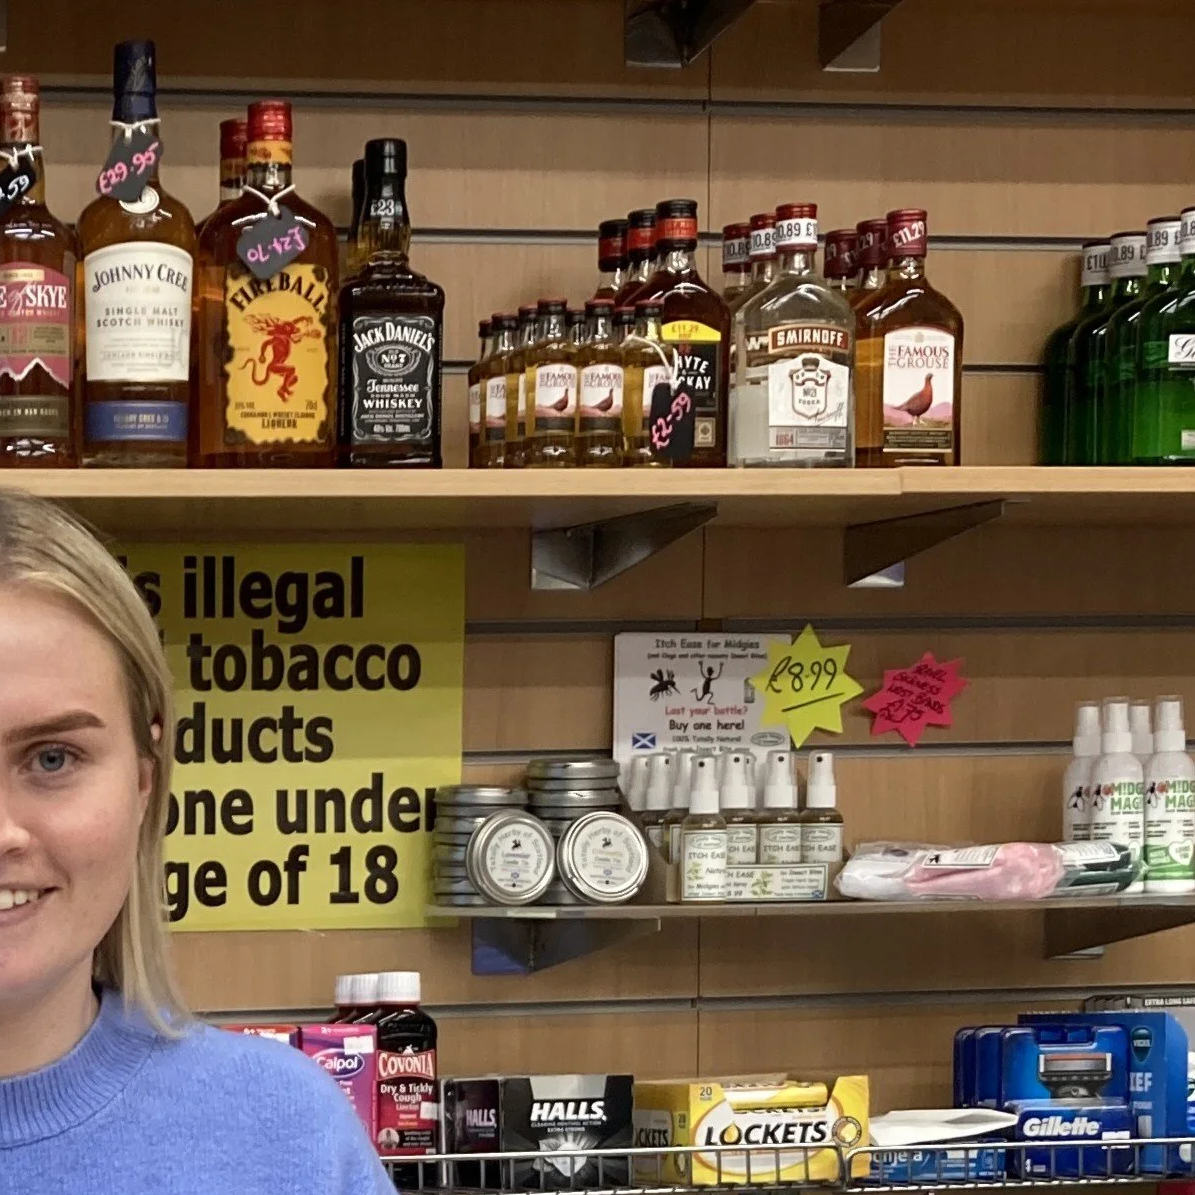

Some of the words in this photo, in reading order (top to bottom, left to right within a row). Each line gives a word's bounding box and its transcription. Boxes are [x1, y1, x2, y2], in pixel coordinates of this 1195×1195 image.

[893, 221, 925, 248] £11.29
[92, 264, 154, 293] JOHNNY
[157, 263, 188, 292] CREE
[26, 285, 67, 309] SKYE
[229, 272, 326, 312] FIREBALL
[105, 307, 146, 316] SINGLE
[152, 307, 178, 316] MALT
[97, 318, 141, 328] SCOTCH
[147, 318, 184, 328] WHISKY
[353, 325, 384, 353] JACK
[386, 321, 435, 353] DANIEL'S
[777, 328, 844, 347] SMIRNOFF
[897, 344, 950, 358] FAMOUS
[677, 355, 710, 373] HYTE
[896, 357, 950, 369] GROUSE
[367, 379, 420, 393] Tennessee
[363, 398, 423, 409] WHISKEY
[183, 556, 365, 634] illegal
[655, 639, 677, 649] Itch
[680, 639, 702, 649] Ease
[186, 629, 422, 692] tobacco
[766, 655, 839, 694] £8.99
[175, 701, 334, 764] ducts
[669, 719, 689, 733] Buy
[693, 721, 712, 731] one
[1111, 796, 1143, 810] MAG
[1165, 795, 1195, 808] MAG
[165, 859, 228, 922] ge
[248, 844, 309, 907] of
[329, 845, 399, 905] 18
[316, 1055, 358, 1072] Calpol
[378, 1052, 434, 1078] COVONIA
[380, 1083, 397, 1095] Dry
[399, 1083, 406, 1093] &
[408, 1083, 433, 1095] Tickly
[700, 1086, 713, 1097] 20
[1131, 1072, 1153, 1092] IEF
[393, 1092, 422, 1102] Cough
[531, 1101, 607, 1121] HALLS
[705, 1121, 827, 1146] LOCKETS
[1023, 1116, 1102, 1138] Gillette
